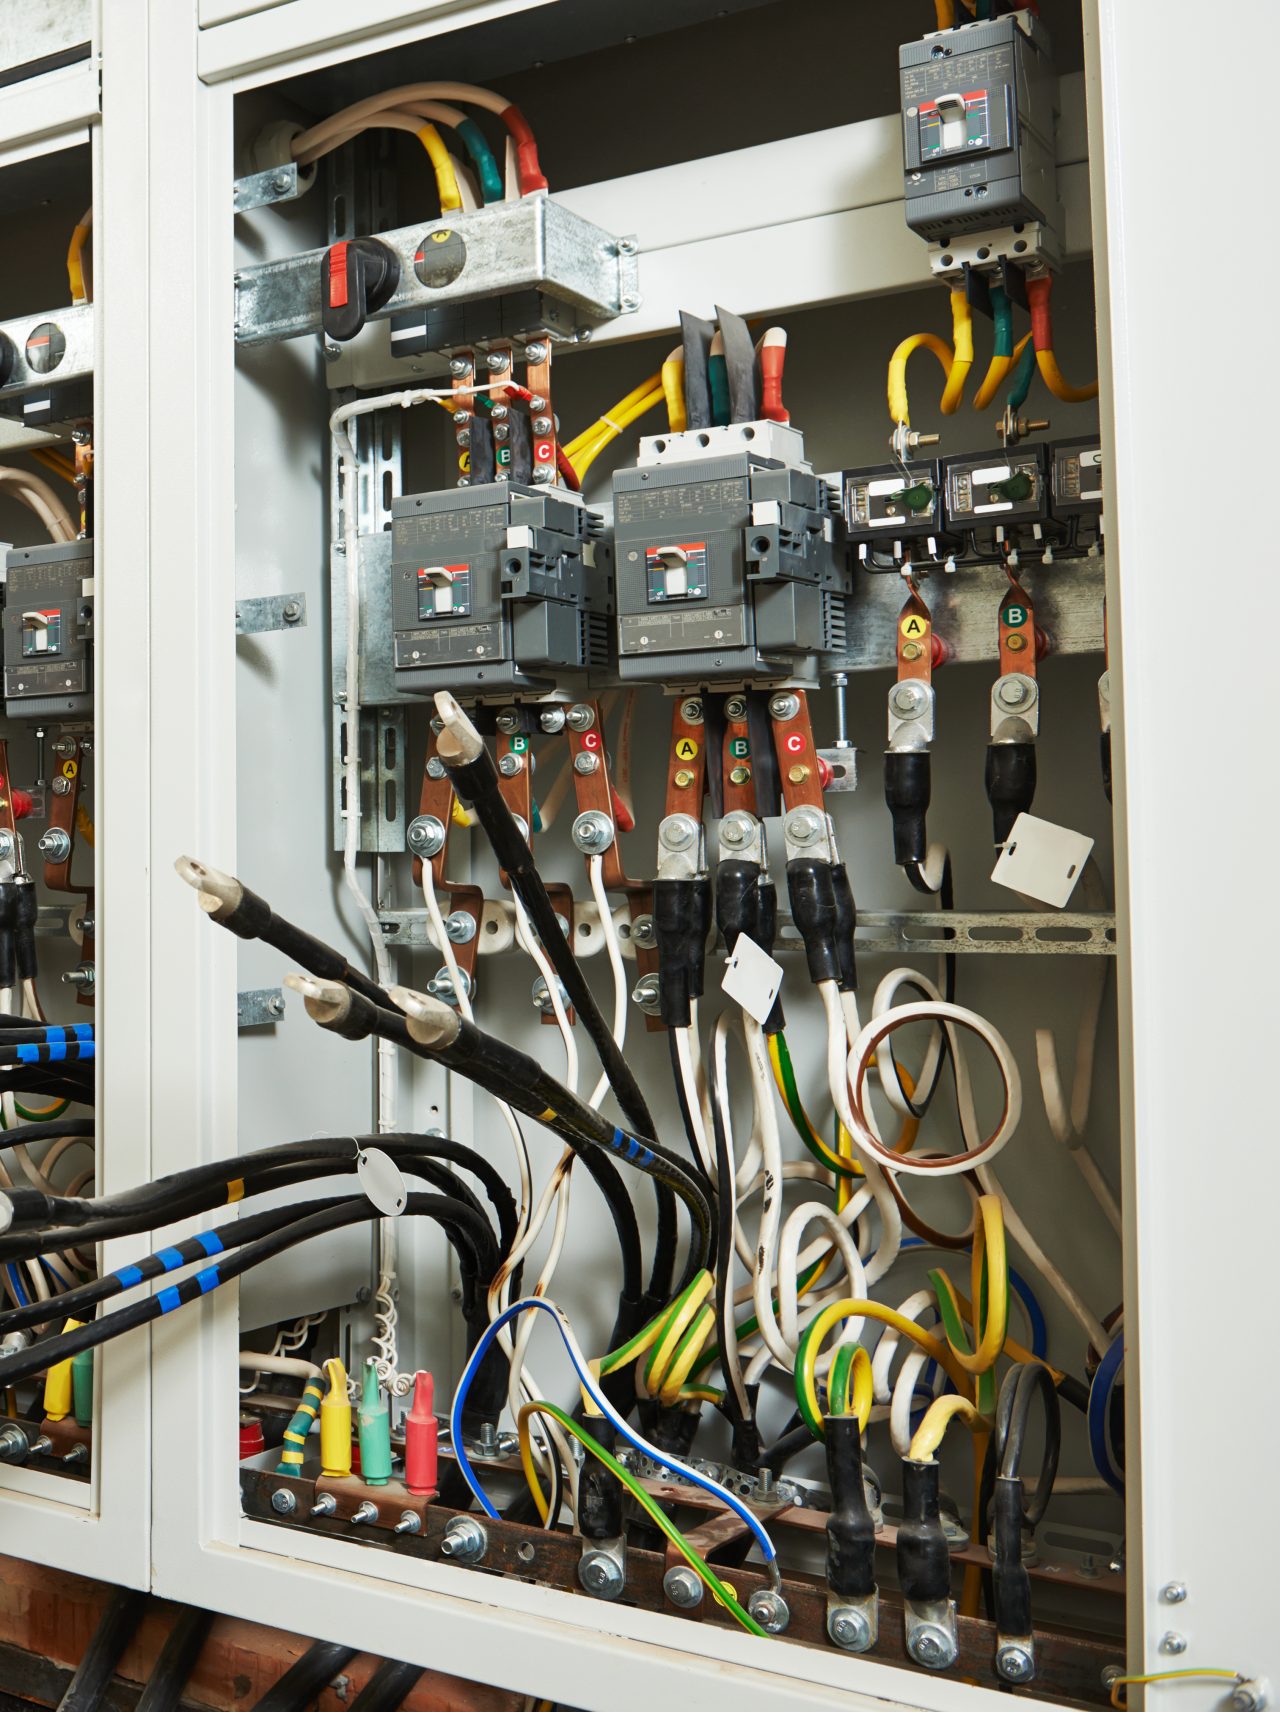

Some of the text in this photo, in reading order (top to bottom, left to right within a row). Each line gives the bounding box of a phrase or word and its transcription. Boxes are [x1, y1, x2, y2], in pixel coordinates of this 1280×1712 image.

[501, 449, 510, 463] B
[538, 444, 550, 459] C
[1008, 608, 1023, 624] B
[906, 619, 921, 634] A
[514, 737, 525, 751] B
[585, 733, 597, 748] C
[787, 736, 801, 751] C
[681, 741, 694, 755] A
[735, 741, 748, 755] B
[65, 763, 74, 774] A
